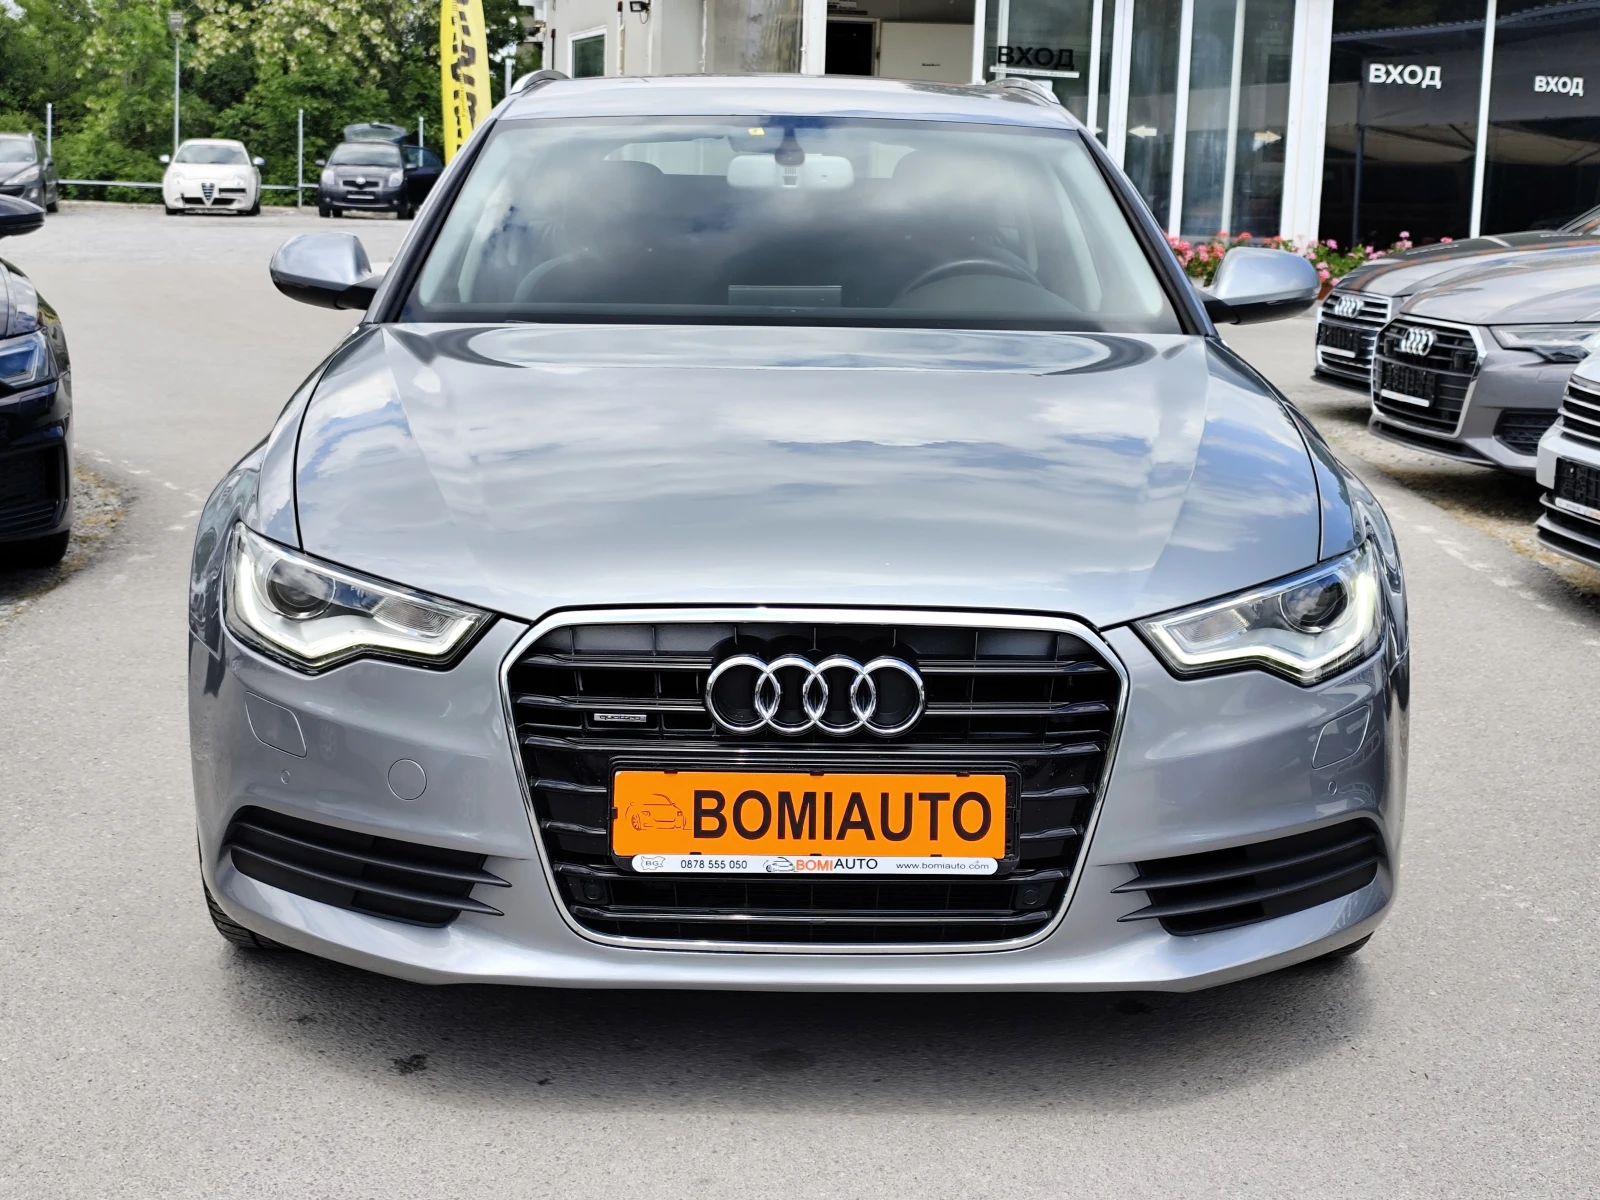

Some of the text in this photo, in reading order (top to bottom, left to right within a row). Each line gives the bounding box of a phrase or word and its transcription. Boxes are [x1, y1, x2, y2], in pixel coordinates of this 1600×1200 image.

[997, 45, 1075, 71] ВХОД
[1368, 63, 1442, 89] ВХОД
[1534, 75, 1584, 97] ВХОД
[693, 789, 992, 842] BOMIAUTO
[680, 859, 748, 869] 0878 555 050
[795, 858, 878, 871] BOMIAUTO
[895, 861, 990, 871] www.bomiauto.com
